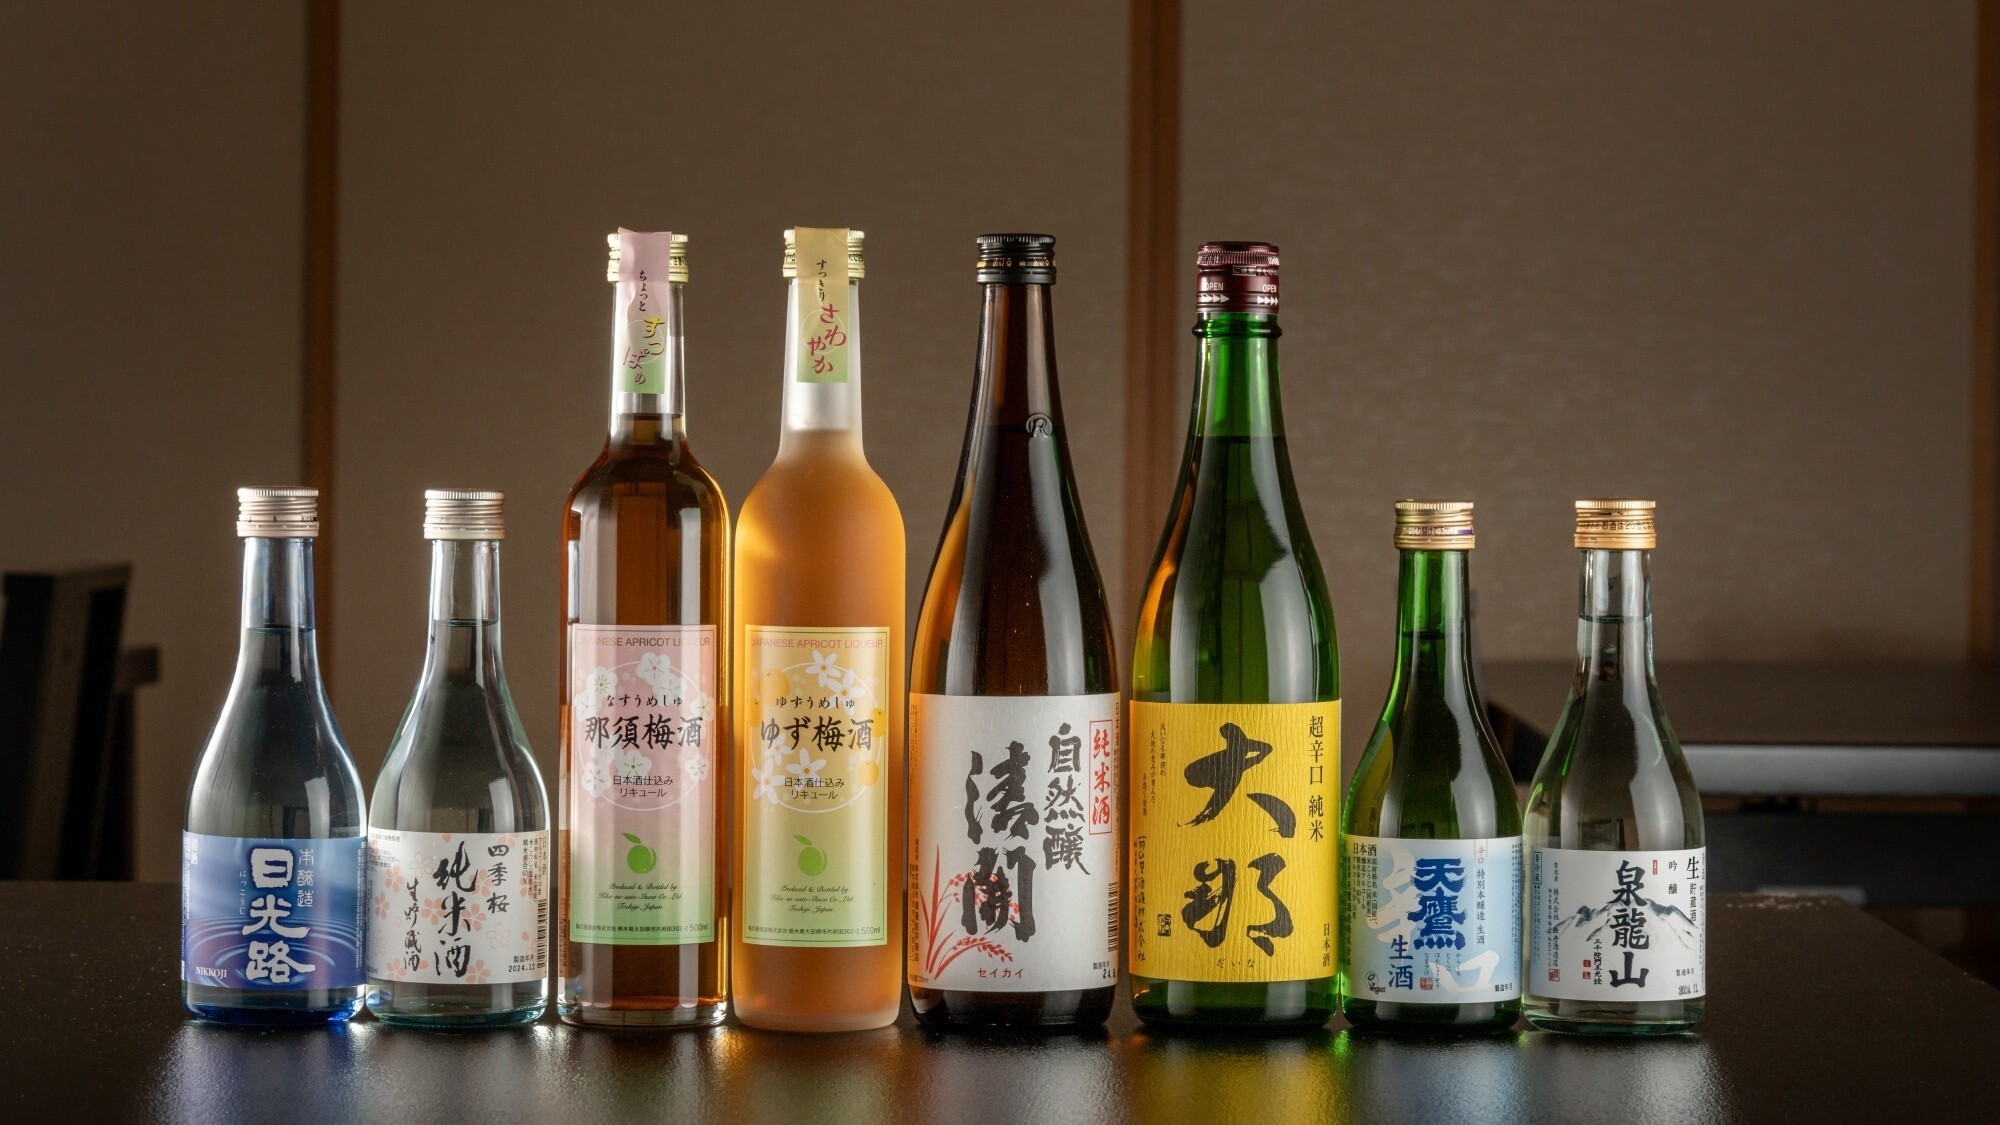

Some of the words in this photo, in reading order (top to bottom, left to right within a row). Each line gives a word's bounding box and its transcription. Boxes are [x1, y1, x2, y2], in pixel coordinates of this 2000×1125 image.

[816, 259, 828, 303] すっきり
[1262, 284, 1277, 293] OPEN
[638, 270, 647, 312] ちょっと
[625, 637, 671, 647] APRICOT
[751, 638, 794, 648] JAPANESE
[797, 639, 842, 649] APRICOT
[845, 639, 883, 649] LIQUEUR
[606, 694, 683, 708] なすうめしゅ
[776, 696, 855, 709] ゆずうめしゅ
[585, 713, 703, 750] 那須梅酒
[761, 715, 874, 752] ゆず梅酒
[1308, 715, 1324, 784] 超辛口
[613, 775, 674, 787] 日本酒仕込み
[784, 777, 845, 788] 日本酒仕込み
[1092, 728, 1111, 826] 純米酒
[620, 788, 667, 798] リキュール
[791, 790, 838, 800] リキュール
[1043, 722, 1090, 876] 自然醸
[1308, 795, 1324, 843] 純米
[1177, 722, 1297, 957] 大那
[1353, 842, 1377, 857] 日本酒
[297, 849, 314, 908] 本醸造
[486, 844, 510, 914] 四季桜
[609, 882, 636, 891] Produced
[669, 883, 678, 892] by
[1668, 861, 1678, 895] 吟醸
[239, 870, 247, 915] にっこうじ
[780, 884, 807, 893] Produced
[817, 885, 840, 893] Bottled
[841, 886, 849, 894] by
[1476, 868, 1486, 922] 特別本醸造
[433, 841, 478, 978] 純米酒
[1407, 858, 1467, 950] 天鷹
[242, 848, 316, 983] 日光路
[1604, 860, 1650, 988] 泉龍山
[690, 923, 709, 932] 500ml
[861, 926, 881, 934] 500ml
[1476, 926, 1485, 945] 生酒
[1322, 922, 1331, 967] 日本酒
[195, 966, 227, 978] NIKKOJI
[508, 963, 536, 973] 2024.12
[1216, 959, 1255, 968] だいな
[1388, 935, 1414, 990] 生酒
[977, 967, 1024, 979] セイカイ
[1368, 981, 1386, 994] Vegan
[1494, 983, 1513, 992] 製造年月
